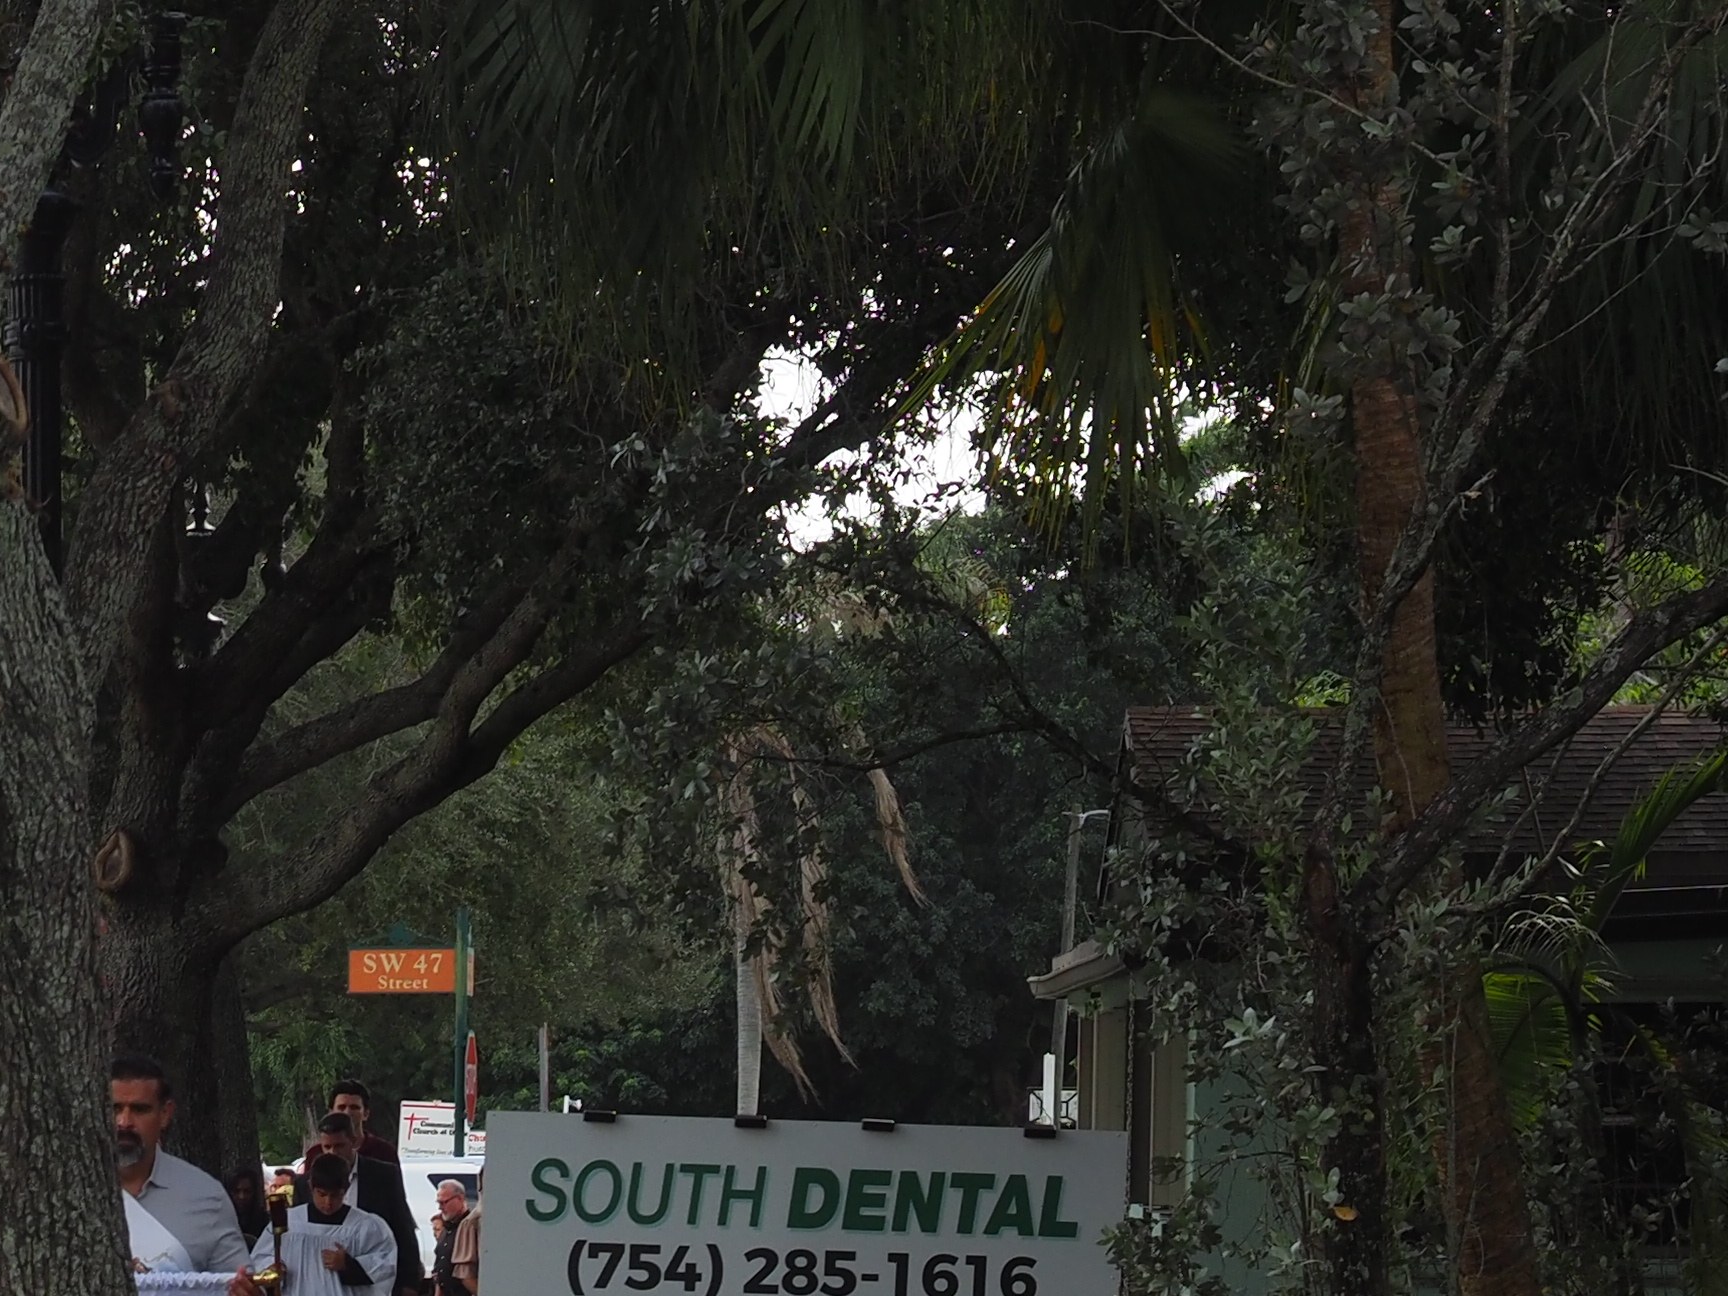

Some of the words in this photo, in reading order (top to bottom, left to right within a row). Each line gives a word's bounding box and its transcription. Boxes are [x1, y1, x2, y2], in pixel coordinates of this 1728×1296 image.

[364, 952, 406, 974] SW
[413, 953, 442, 974] 47
[378, 975, 428, 989] Street
[525, 1158, 767, 1226] SOUTH
[786, 1167, 1078, 1237] DENTAL
